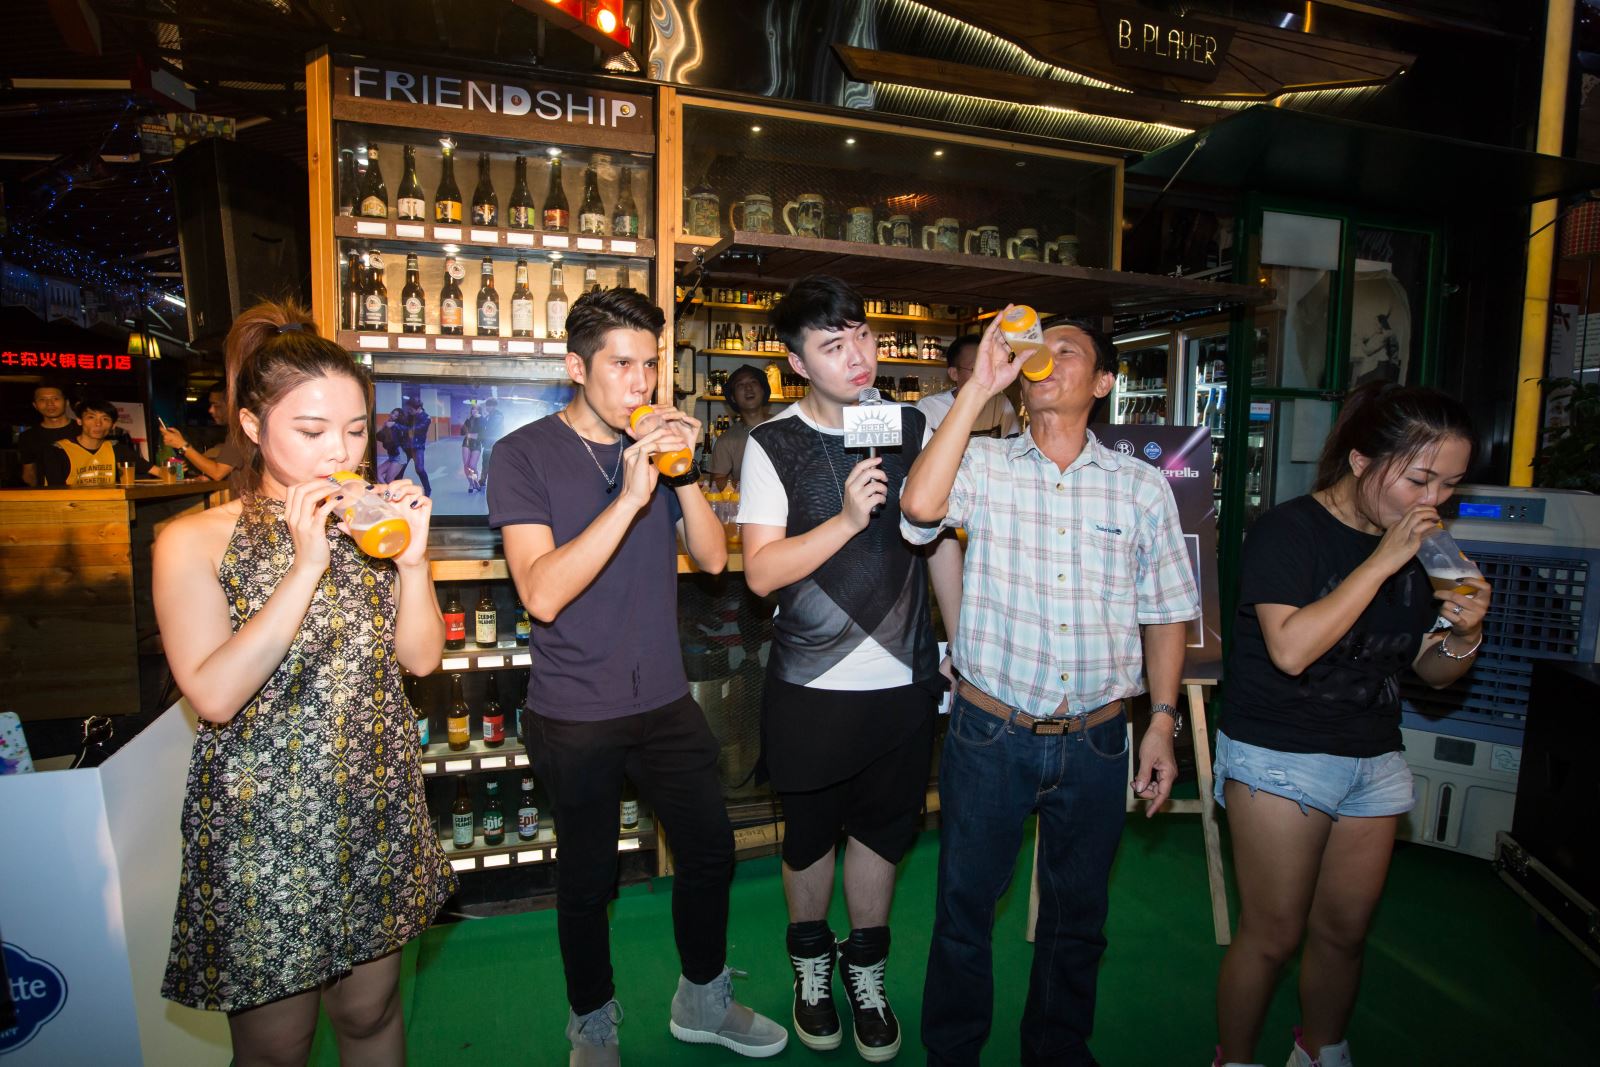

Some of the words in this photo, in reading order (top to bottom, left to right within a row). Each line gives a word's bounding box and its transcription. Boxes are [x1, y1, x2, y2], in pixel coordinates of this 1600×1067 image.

[353, 66, 637, 128] FRIENDSHIP
[861, 423, 885, 432] BEER
[847, 431, 899, 446] PLAYER
[1157, 466, 1200, 478] erella
